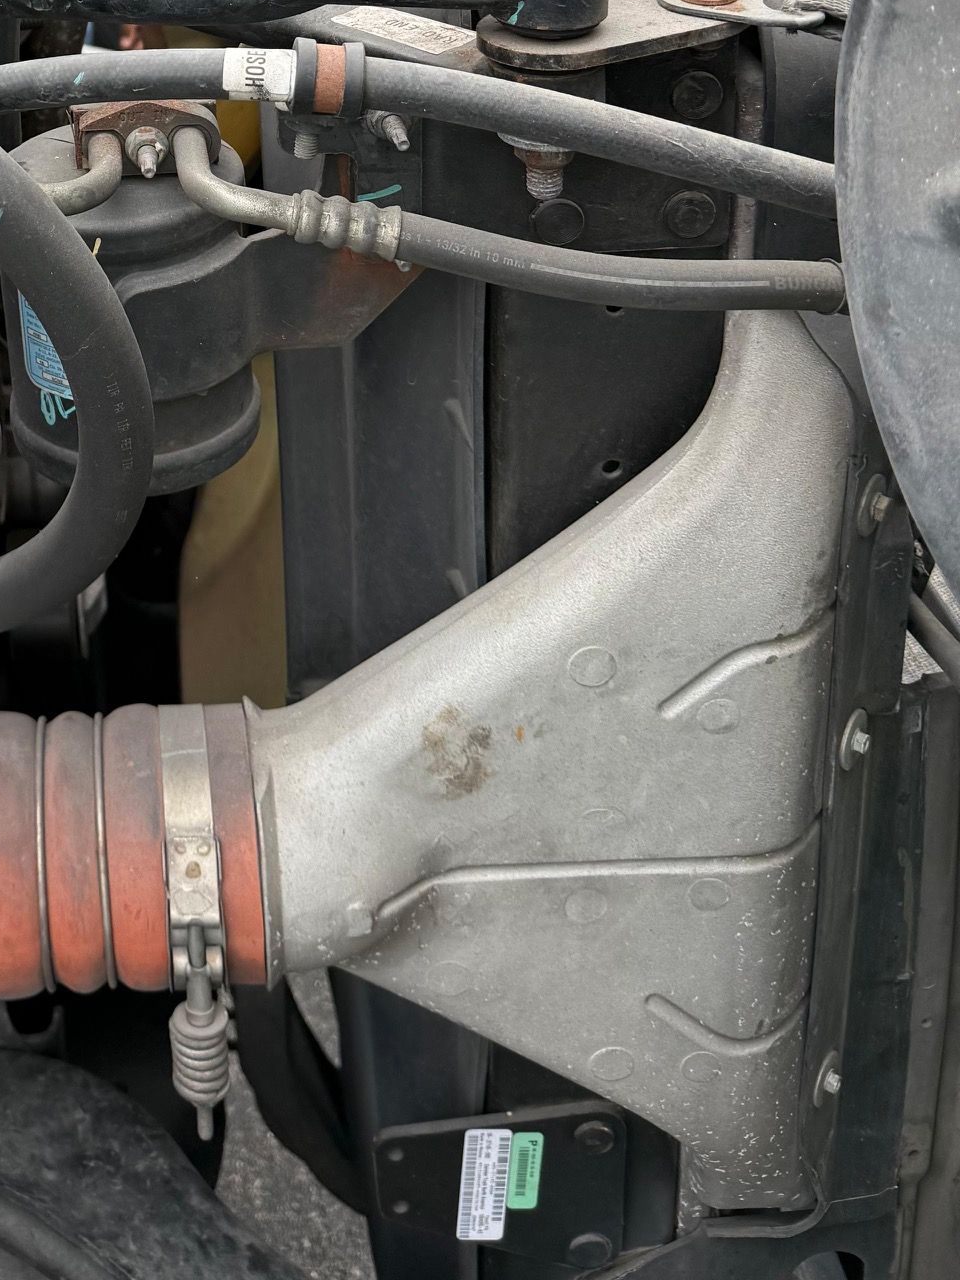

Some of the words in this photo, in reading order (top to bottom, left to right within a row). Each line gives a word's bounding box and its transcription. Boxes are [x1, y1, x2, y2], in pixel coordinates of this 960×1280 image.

[244, 50, 267, 88] HOSE
[435, 238, 467, 256] 13/32
[469, 246, 481, 258] in
[486, 251, 500, 263] 10
